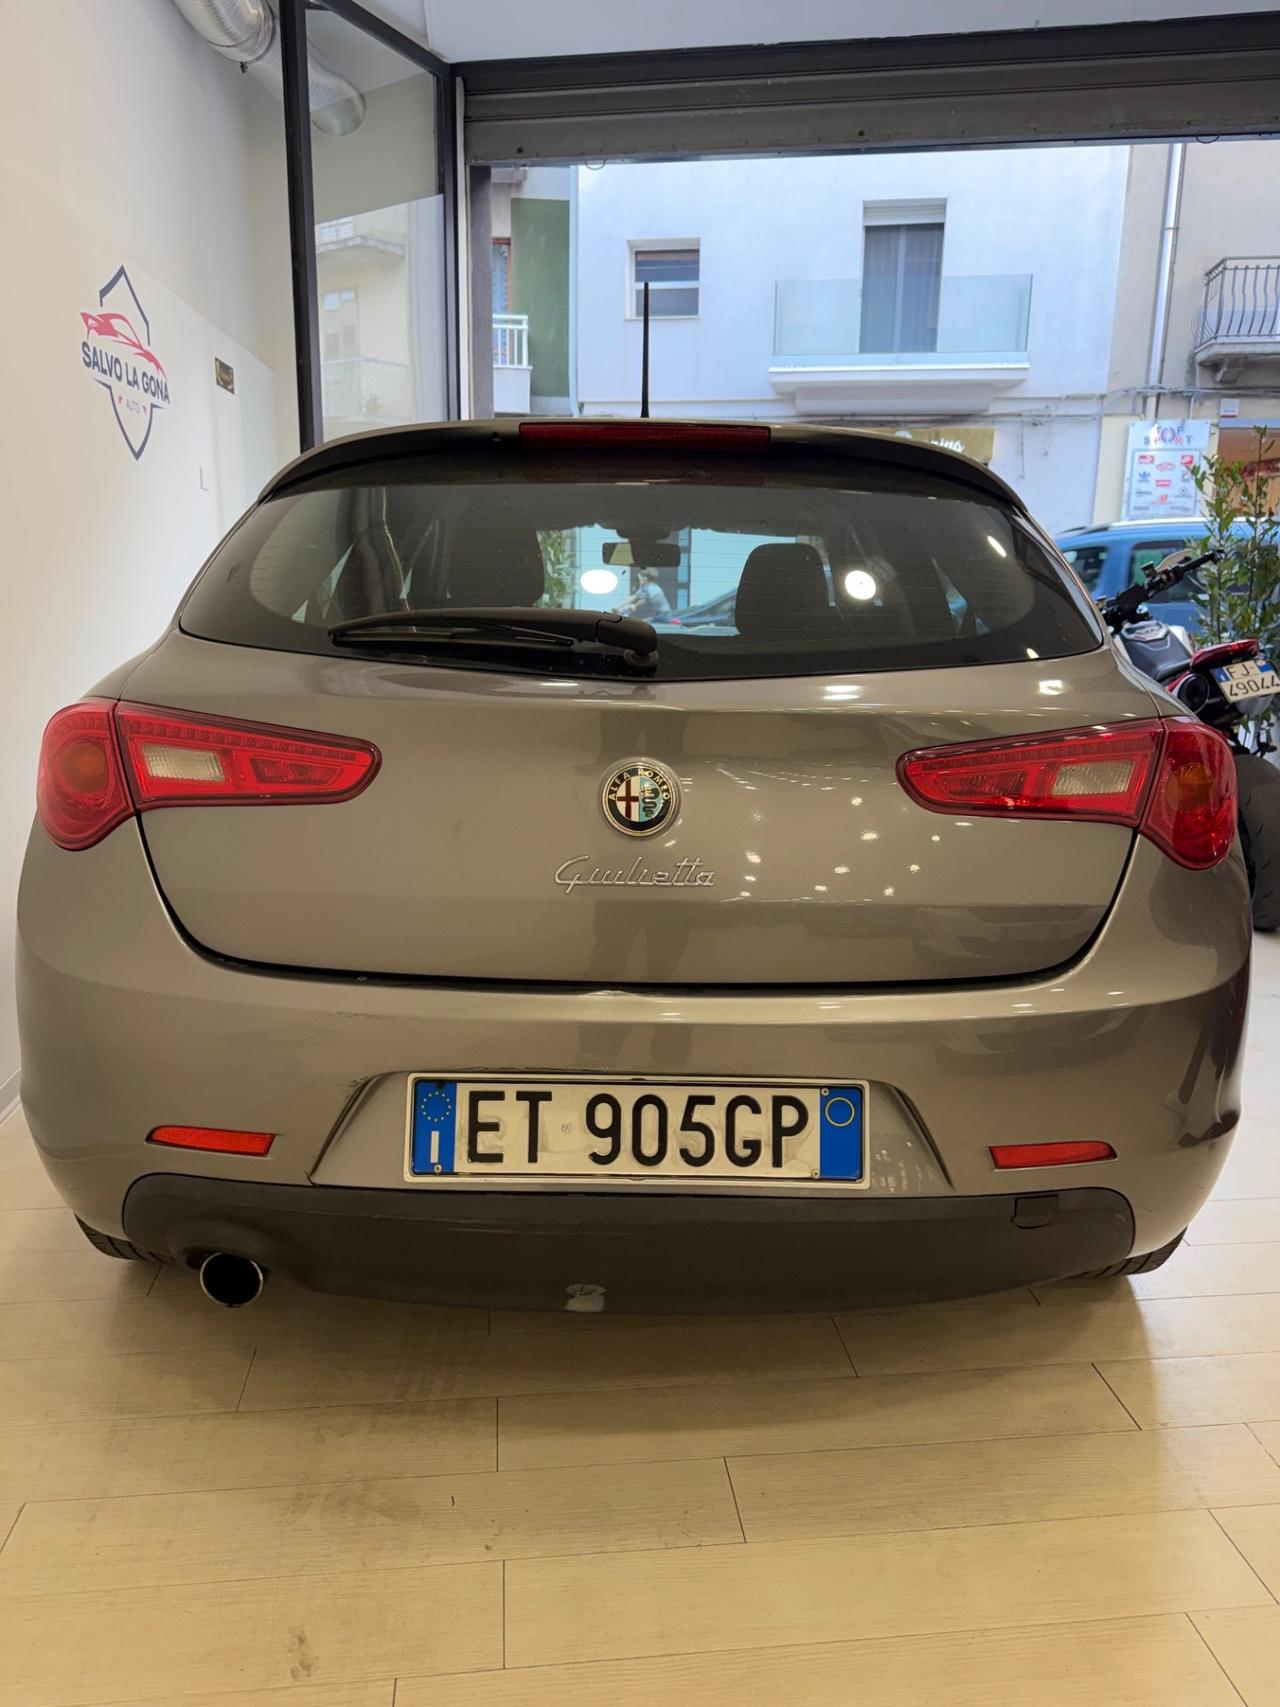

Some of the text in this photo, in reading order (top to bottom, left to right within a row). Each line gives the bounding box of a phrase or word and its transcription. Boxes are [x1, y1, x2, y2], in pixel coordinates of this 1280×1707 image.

[82, 341, 170, 404] SALVO LA GONA
[1157, 426, 1185, 442] TOP
[1226, 663, 1250, 679] FJ
[1229, 674, 1280, 697] 49044
[608, 768, 671, 801] ALFA ROMEO
[555, 855, 715, 894] Giulietta
[467, 1090, 809, 1168] ET 905GP
